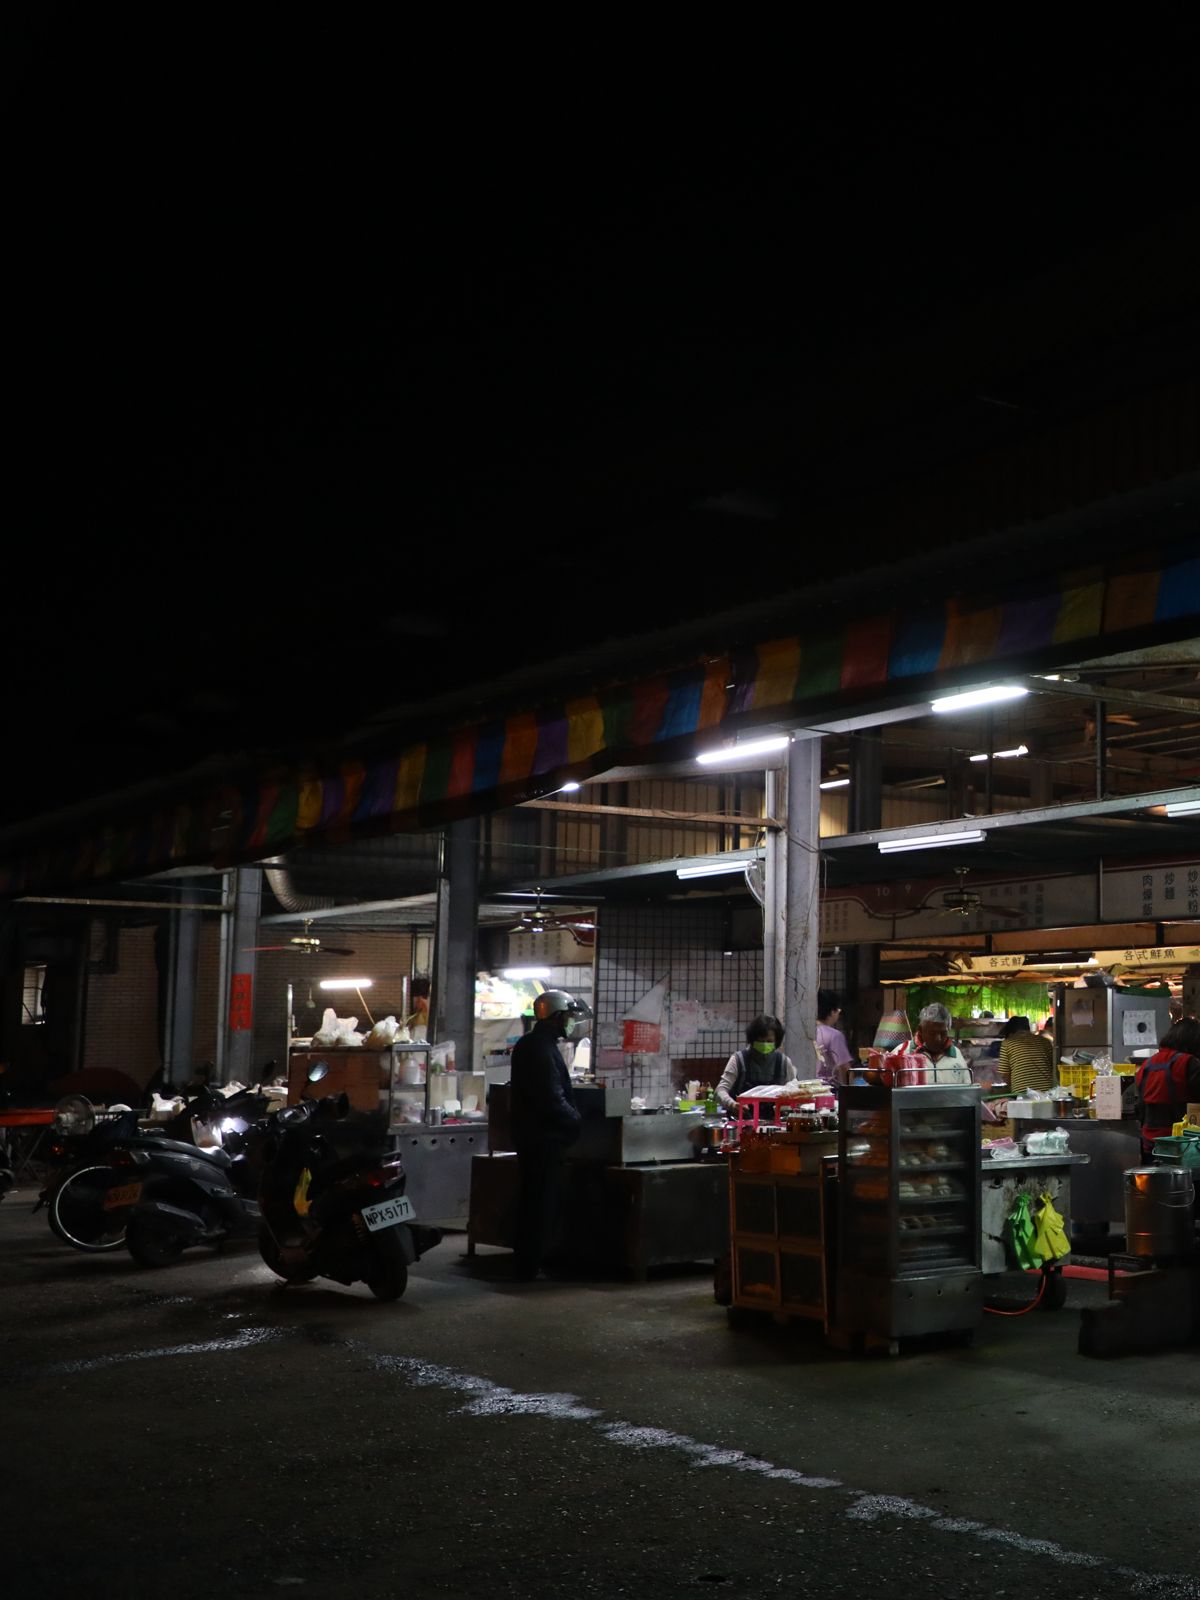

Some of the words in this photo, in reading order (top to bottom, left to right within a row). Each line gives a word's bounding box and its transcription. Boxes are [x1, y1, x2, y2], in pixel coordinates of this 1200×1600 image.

[877, 887, 890, 897] 10
[905, 883, 912, 894] 9
[1188, 869, 1198, 913] 炒米粉
[1123, 948, 1176, 961] 各式鮮魚
